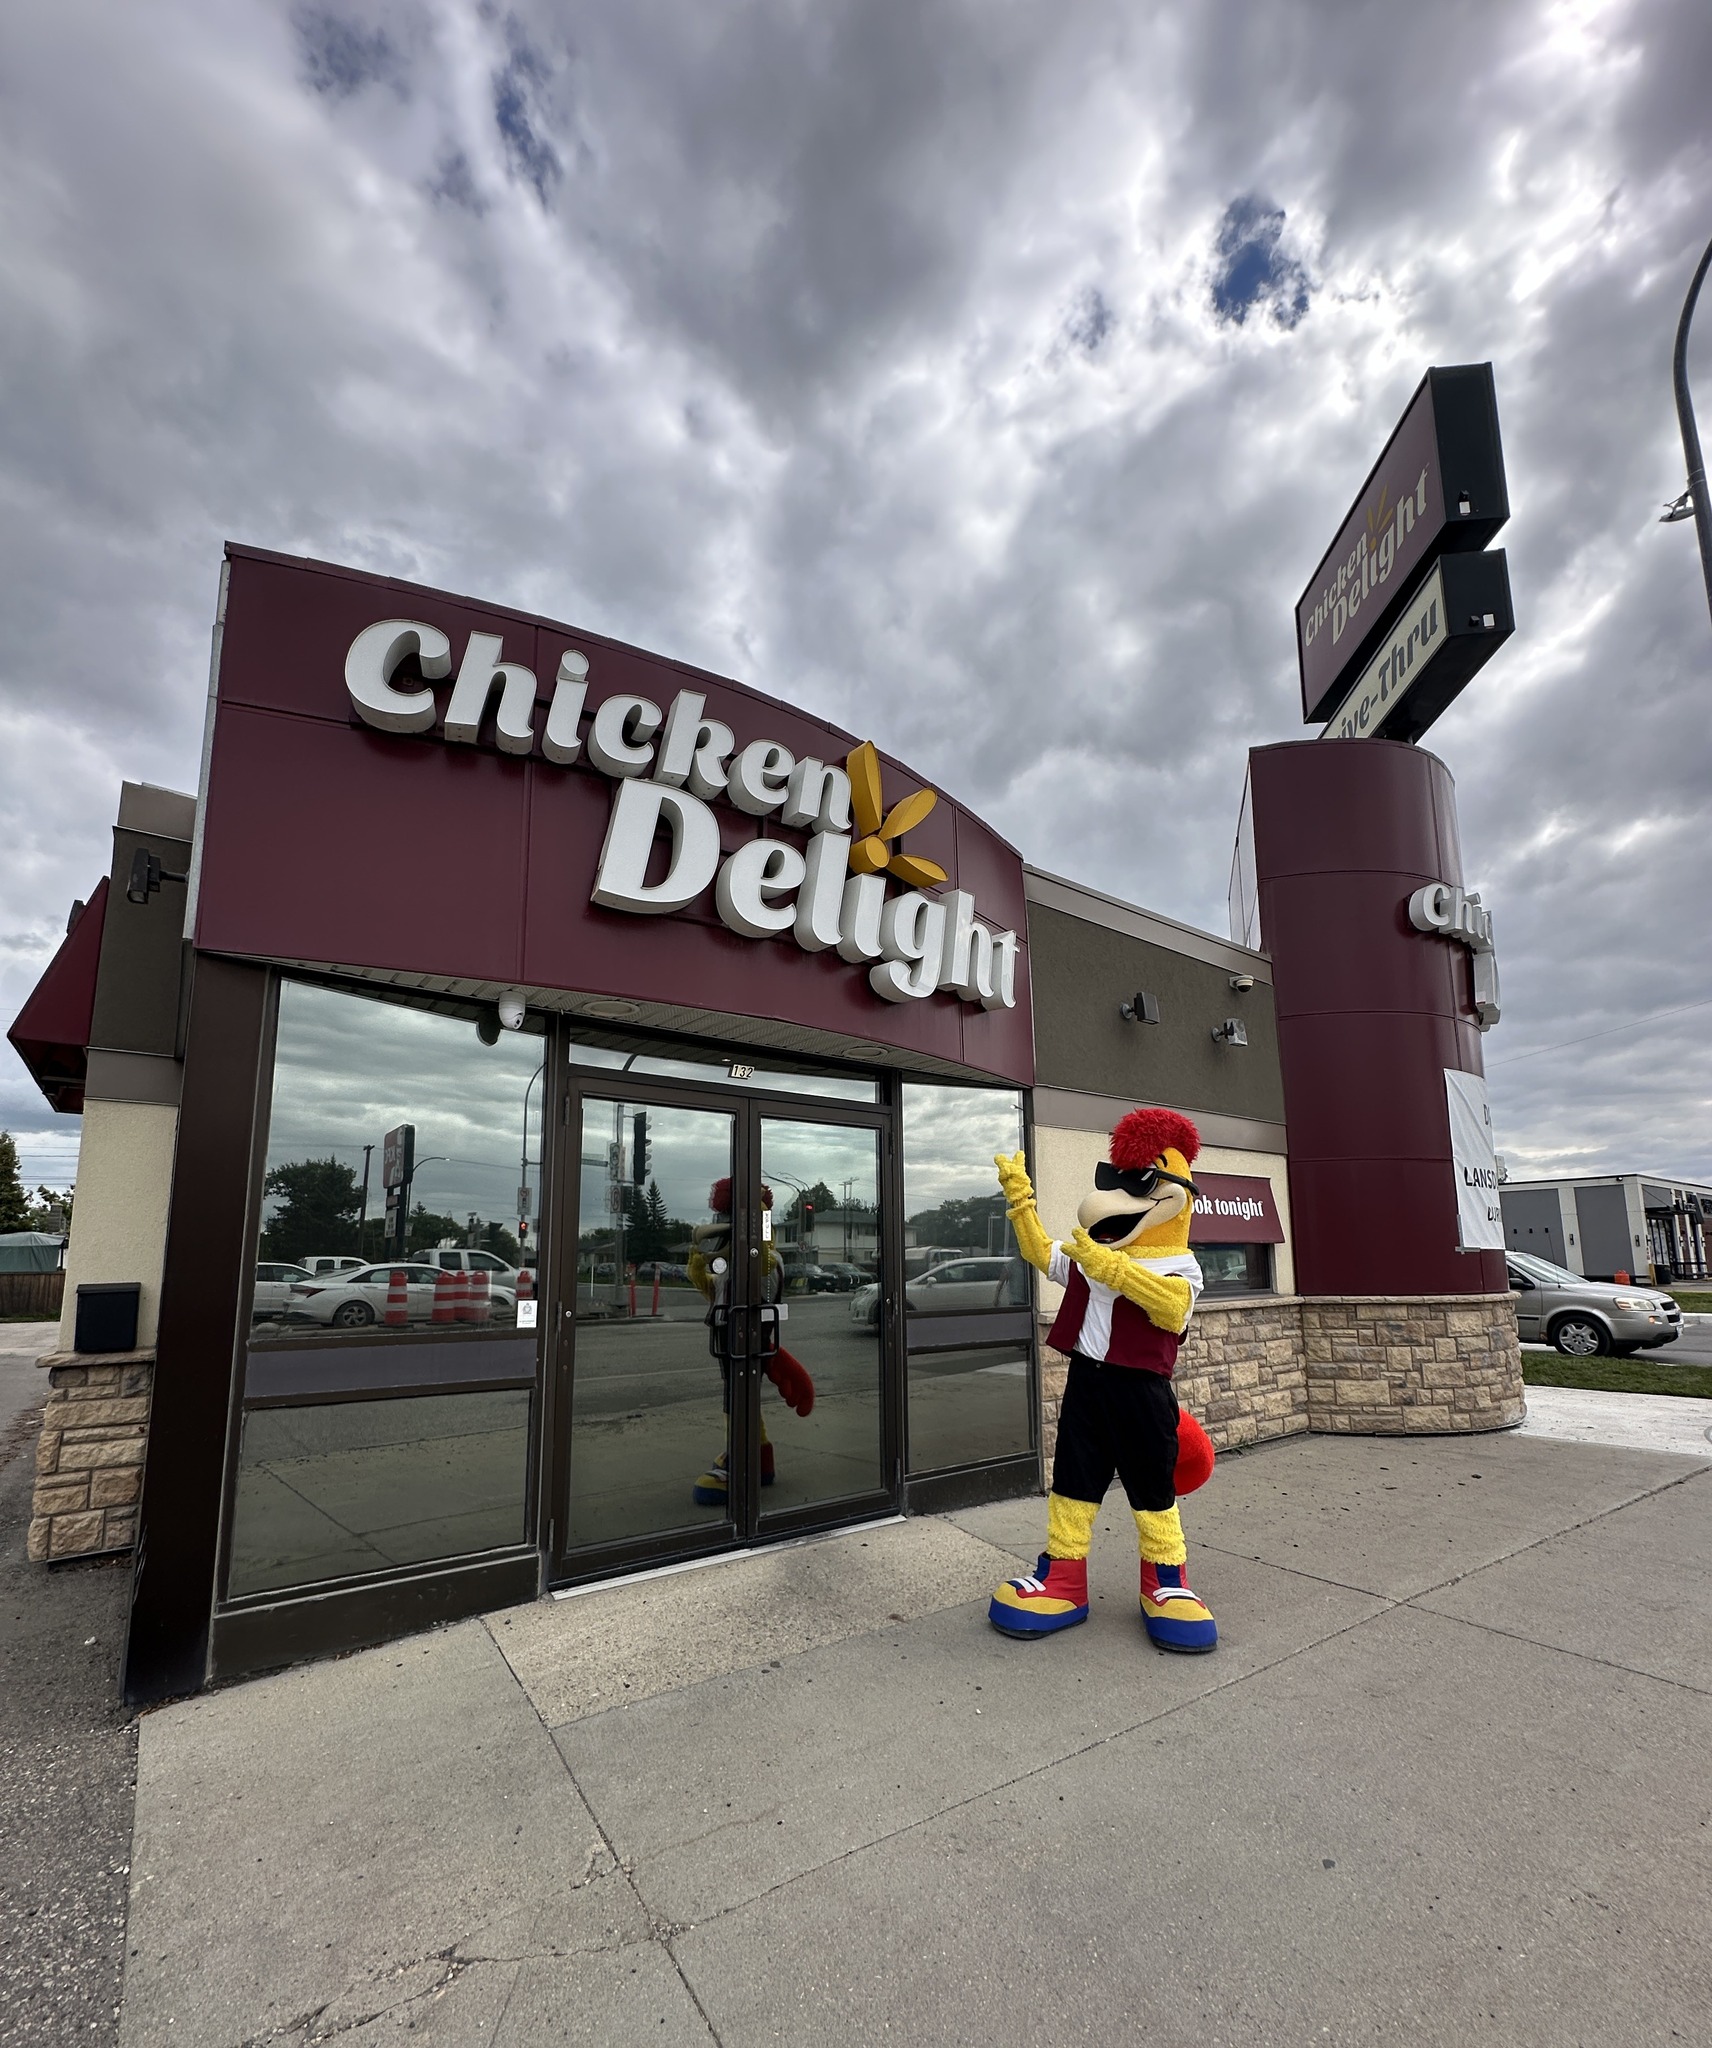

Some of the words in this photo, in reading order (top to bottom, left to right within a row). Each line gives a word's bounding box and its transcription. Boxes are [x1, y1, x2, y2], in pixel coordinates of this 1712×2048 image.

[1305, 531, 1368, 647] Chicken
[1332, 467, 1428, 646] Delight
[344, 618, 853, 833] Chicken
[1340, 598, 1438, 739] ive-Thru
[592, 775, 1021, 1011] Delight
[734, 1065, 754, 1078] 132
[1214, 1196, 1264, 1221] tonight
